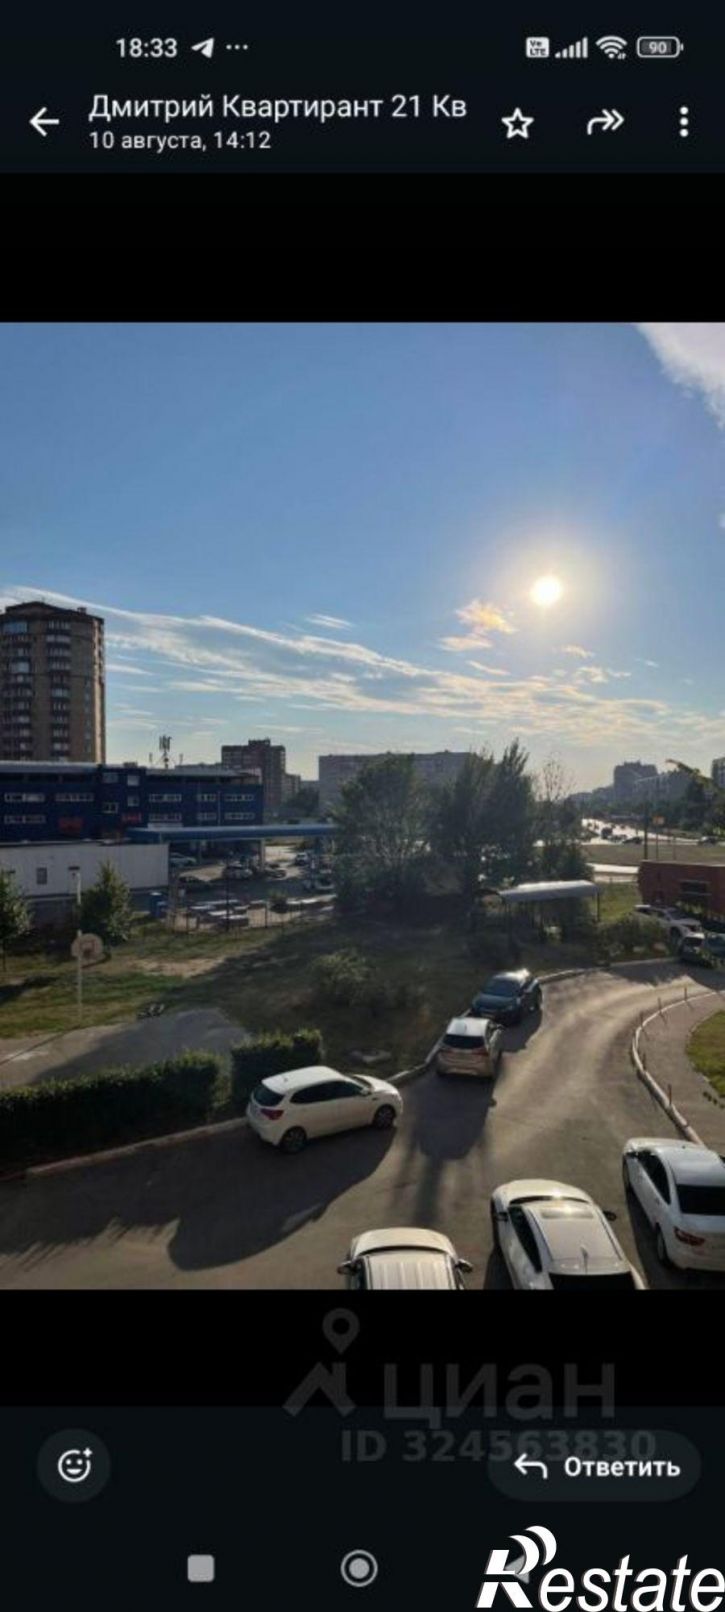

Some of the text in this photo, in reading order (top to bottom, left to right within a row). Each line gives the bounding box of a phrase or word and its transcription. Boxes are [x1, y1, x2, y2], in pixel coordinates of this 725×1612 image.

[116, 37, 178, 58] 18:33
[648, 40, 667, 54] 90
[89, 93, 467, 122] Дмитрий Квартирант 21 Кв
[89, 132, 271, 153] 10 августа, 14:12
[563, 1455, 681, 1477] Ответить
